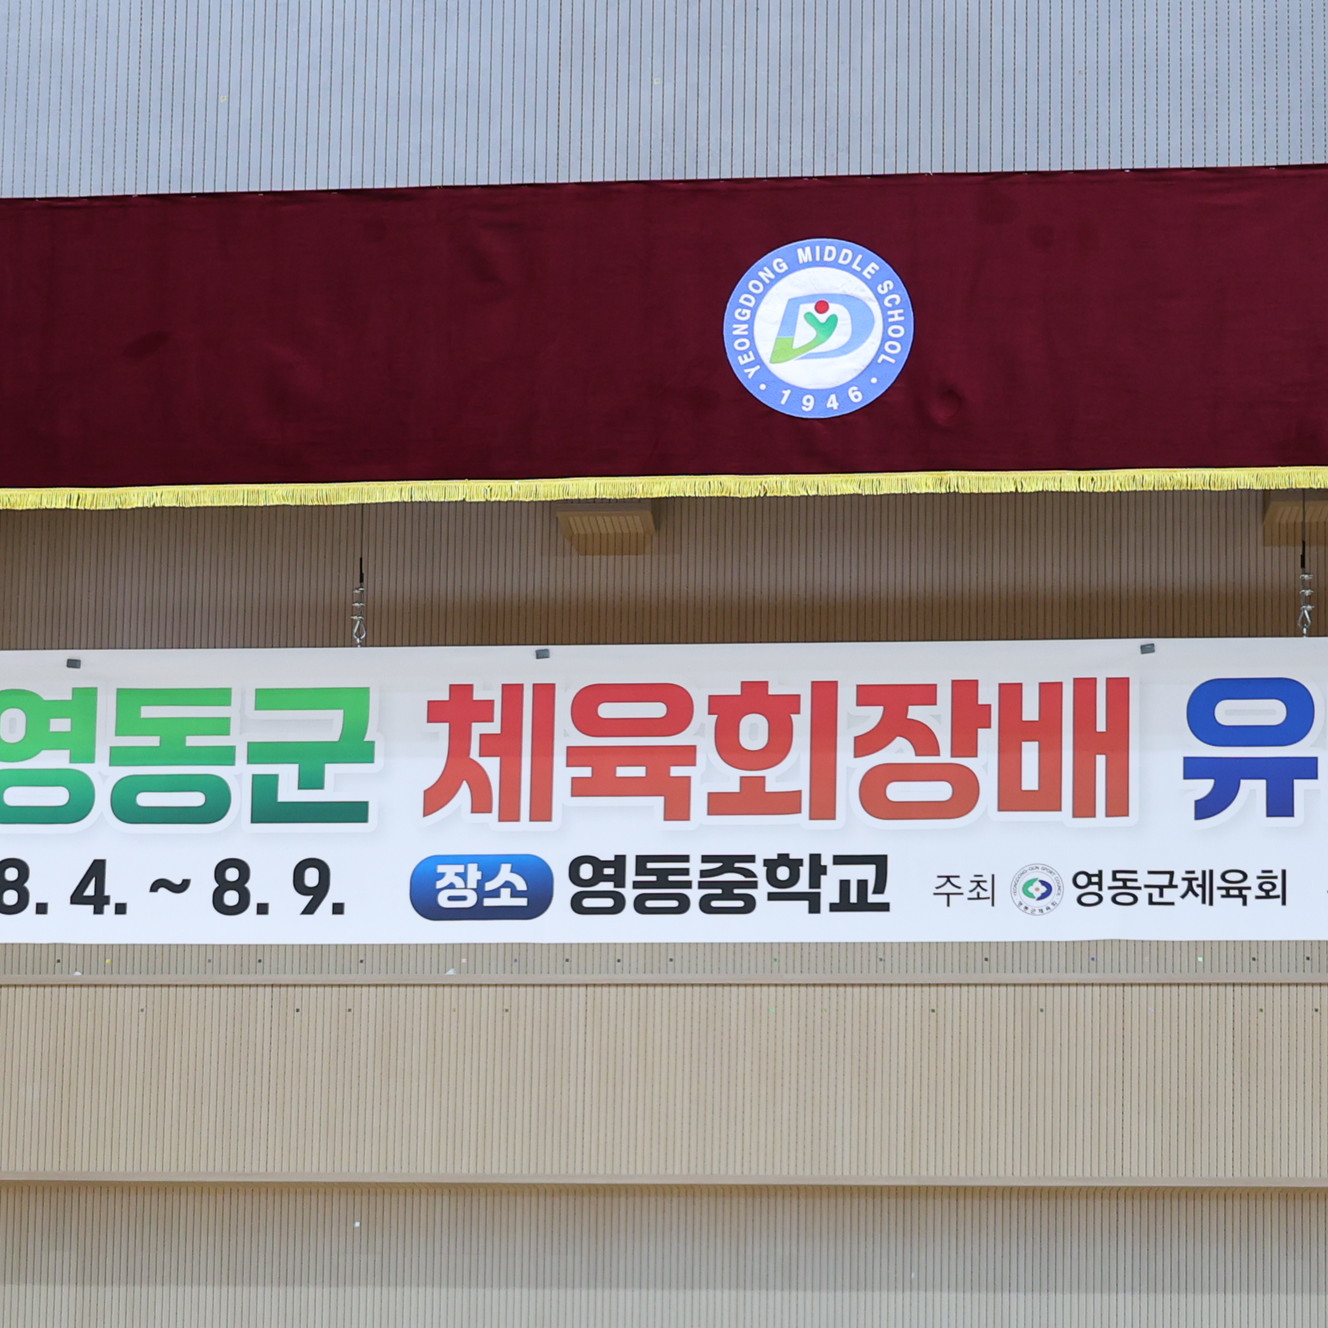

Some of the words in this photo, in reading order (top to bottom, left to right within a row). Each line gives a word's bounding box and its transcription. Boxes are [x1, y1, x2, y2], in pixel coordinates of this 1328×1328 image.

[732, 257, 789, 379] YEONGDONG
[796, 245, 880, 280] MIDDLE
[876, 279, 905, 365] SCHOOL
[422, 676, 1131, 823] 체육회장배
[69, 859, 127, 915] 4.
[212, 857, 269, 916] 8.
[292, 857, 346, 915] 9.
[434, 860, 530, 909] 장소
[567, 853, 891, 916] 영동중학교
[932, 873, 996, 908] 주최
[1071, 867, 1288, 909] 영동군체육회
